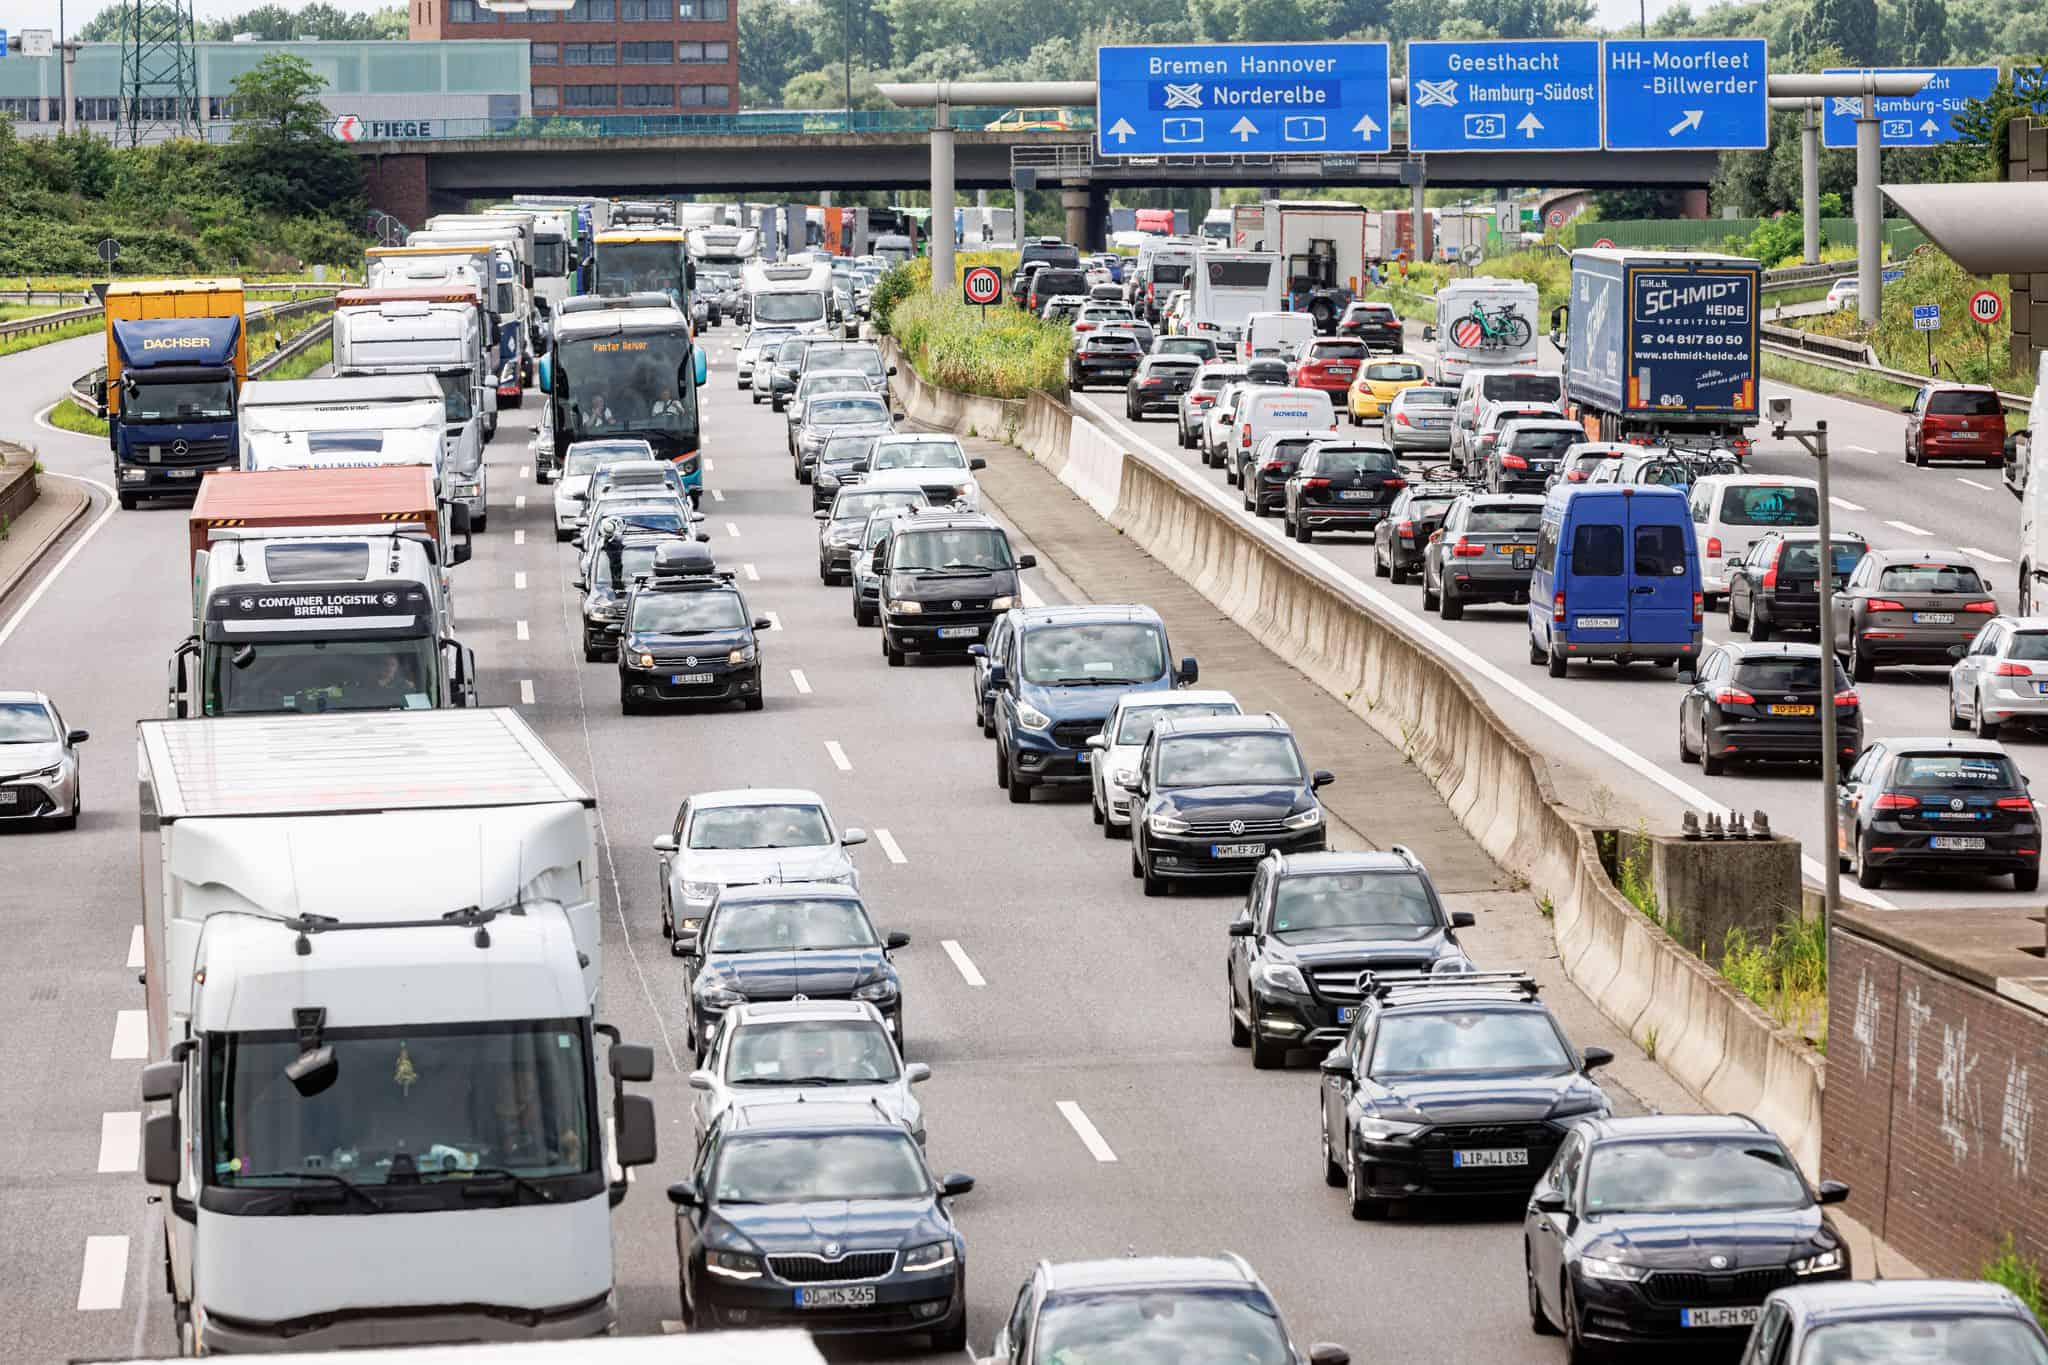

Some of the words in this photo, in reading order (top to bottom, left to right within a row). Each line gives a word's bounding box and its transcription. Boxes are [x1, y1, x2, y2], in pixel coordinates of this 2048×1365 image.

[1149, 57, 1227, 75] Bremen
[1240, 55, 1337, 73] Hannover
[1448, 52, 1559, 71] Geesthacht
[1612, 51, 1749, 70] HH-Moorfleet
[1642, 76, 1758, 94] -Billwerder
[1213, 85, 1326, 105] Norderelbe
[1469, 83, 1594, 106] Hamburg-Südost
[373, 122, 431, 137] FIEGE
[1179, 122, 1186, 137] 1
[1302, 121, 1309, 137] 1
[1475, 119, 1495, 134] 25
[1890, 123, 1905, 135] 25
[973, 278, 992, 293] 100
[1644, 282, 1741, 316] SCHMIDT
[1976, 299, 1996, 314] 100
[1706, 304, 1745, 316] HEIDE
[1658, 318, 1726, 326] SPEDITION
[144, 337, 210, 350] DACHSER
[1657, 334, 1674, 345] 04
[1706, 334, 1723, 345] 80
[1725, 335, 1743, 345] 50
[1634, 351, 1749, 361] www.schmidt-heide.de
[258, 596, 323, 607] CONTAINER
[327, 594, 379, 605] LOGISTIK
[294, 606, 343, 616] BREMEN
[1462, 1152, 1482, 1165] LIP
[1489, 1151, 1503, 1164] LI
[1506, 1151, 1526, 1164] 832
[848, 1287, 874, 1302] 365
[1693, 1311, 1709, 1324] MI
[1719, 1310, 1738, 1323] FH
